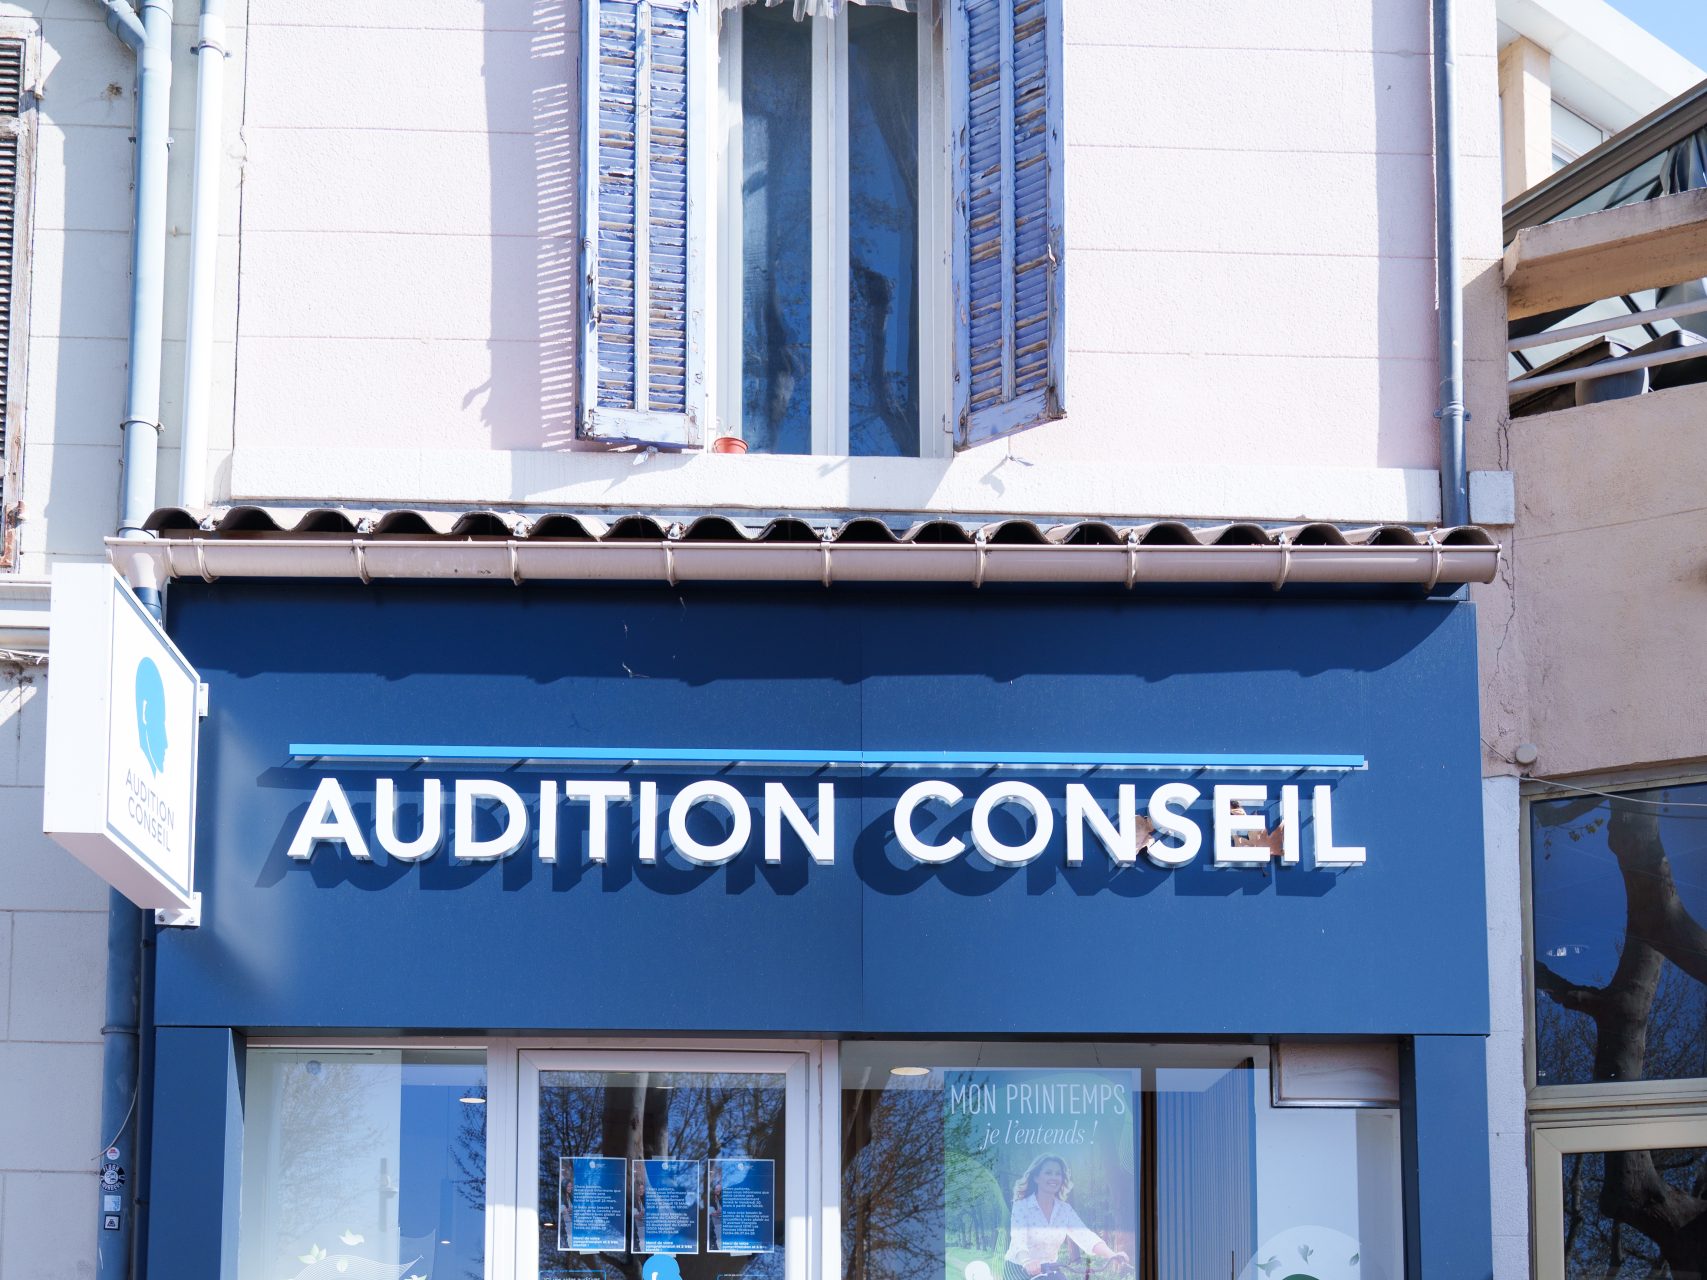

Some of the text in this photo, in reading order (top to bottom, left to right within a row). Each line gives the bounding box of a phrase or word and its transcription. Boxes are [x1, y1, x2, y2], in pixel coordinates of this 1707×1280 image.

[126, 768, 174, 830] AUDITION
[128, 796, 171, 852] CONSEIL
[287, 778, 1366, 867] AUDITION CONSEIL
[951, 1083, 1126, 1115] MON PRINTEMPS
[979, 1121, 1001, 1150] je
[1004, 1119, 1085, 1145] l'entends
